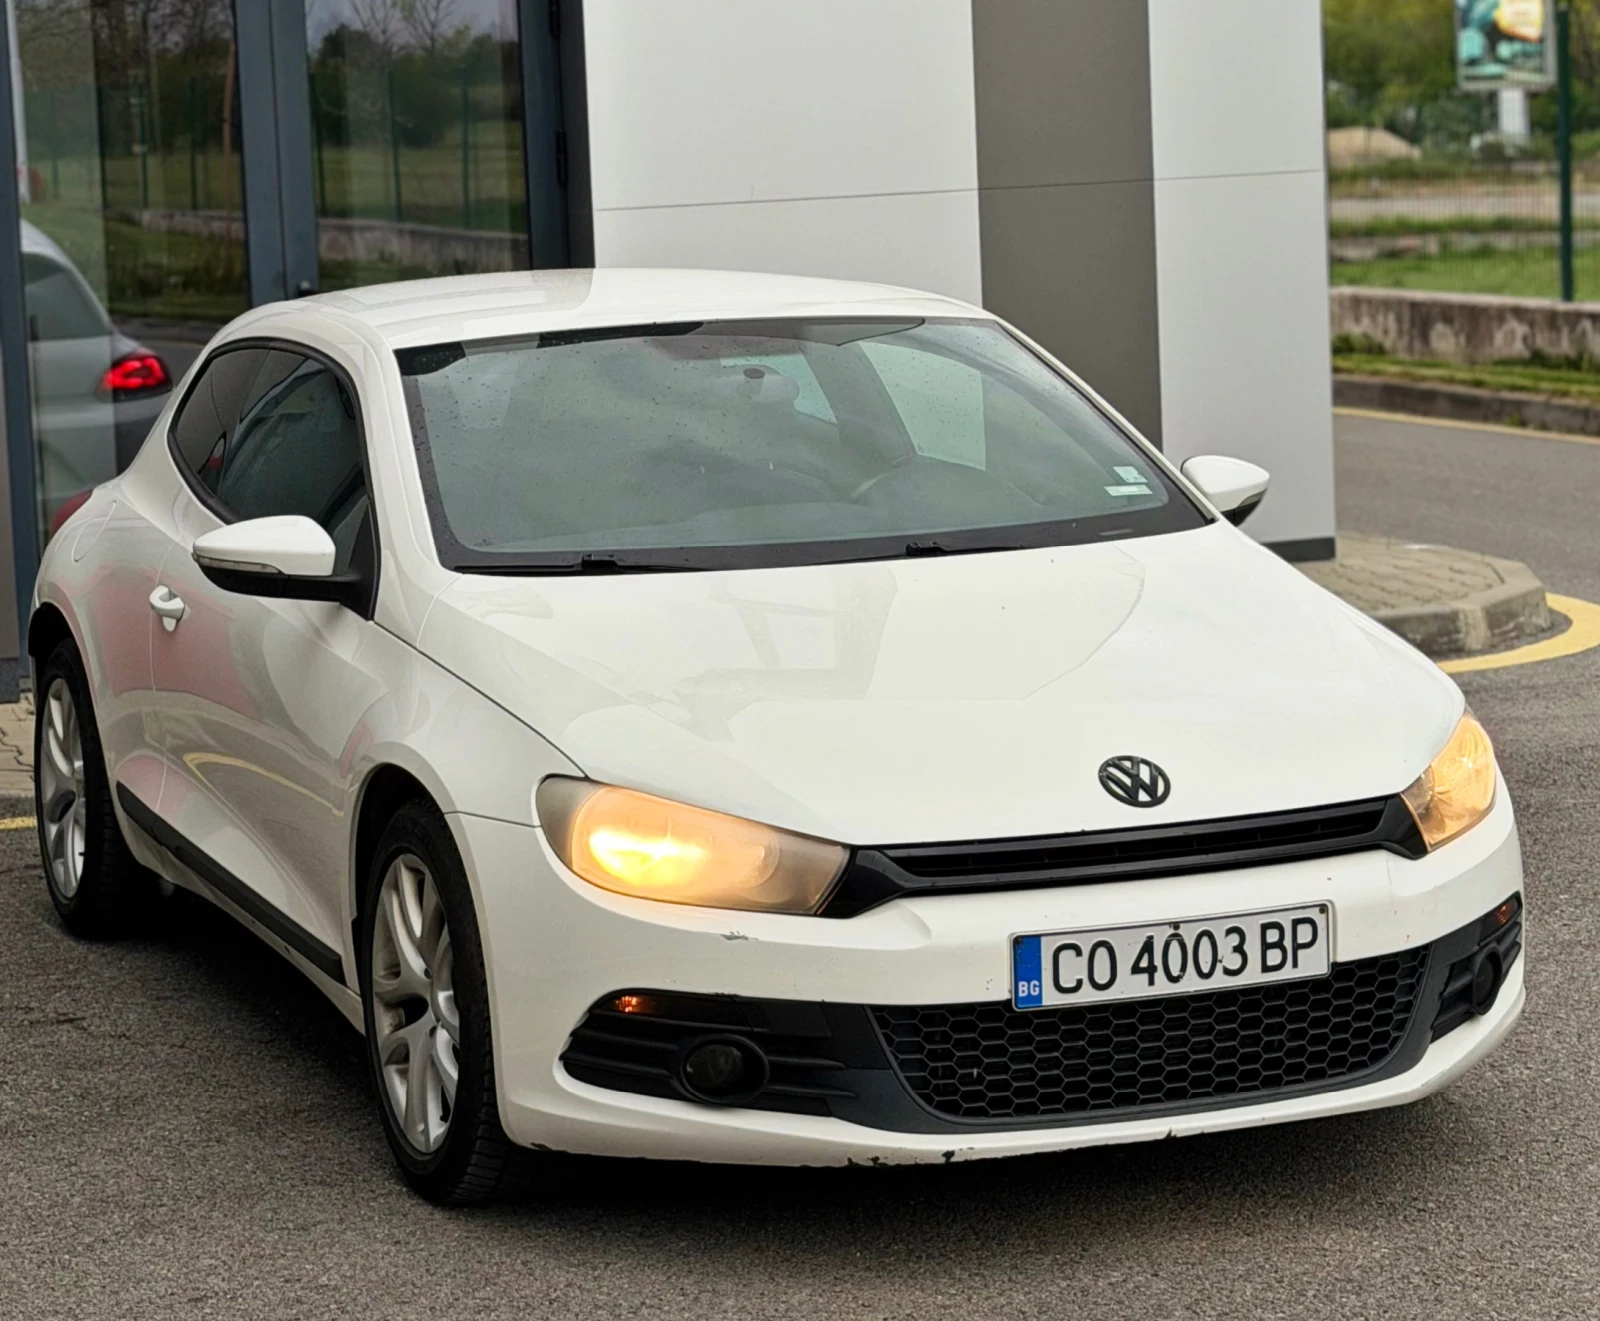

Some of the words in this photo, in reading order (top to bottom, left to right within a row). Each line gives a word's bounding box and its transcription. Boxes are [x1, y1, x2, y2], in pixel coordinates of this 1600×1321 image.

[1098, 755, 1171, 808] VW
[1052, 939, 1118, 994] CO
[1130, 925, 1249, 986] 4003
[1260, 916, 1319, 974] BP
[1018, 980, 1040, 998] BG
